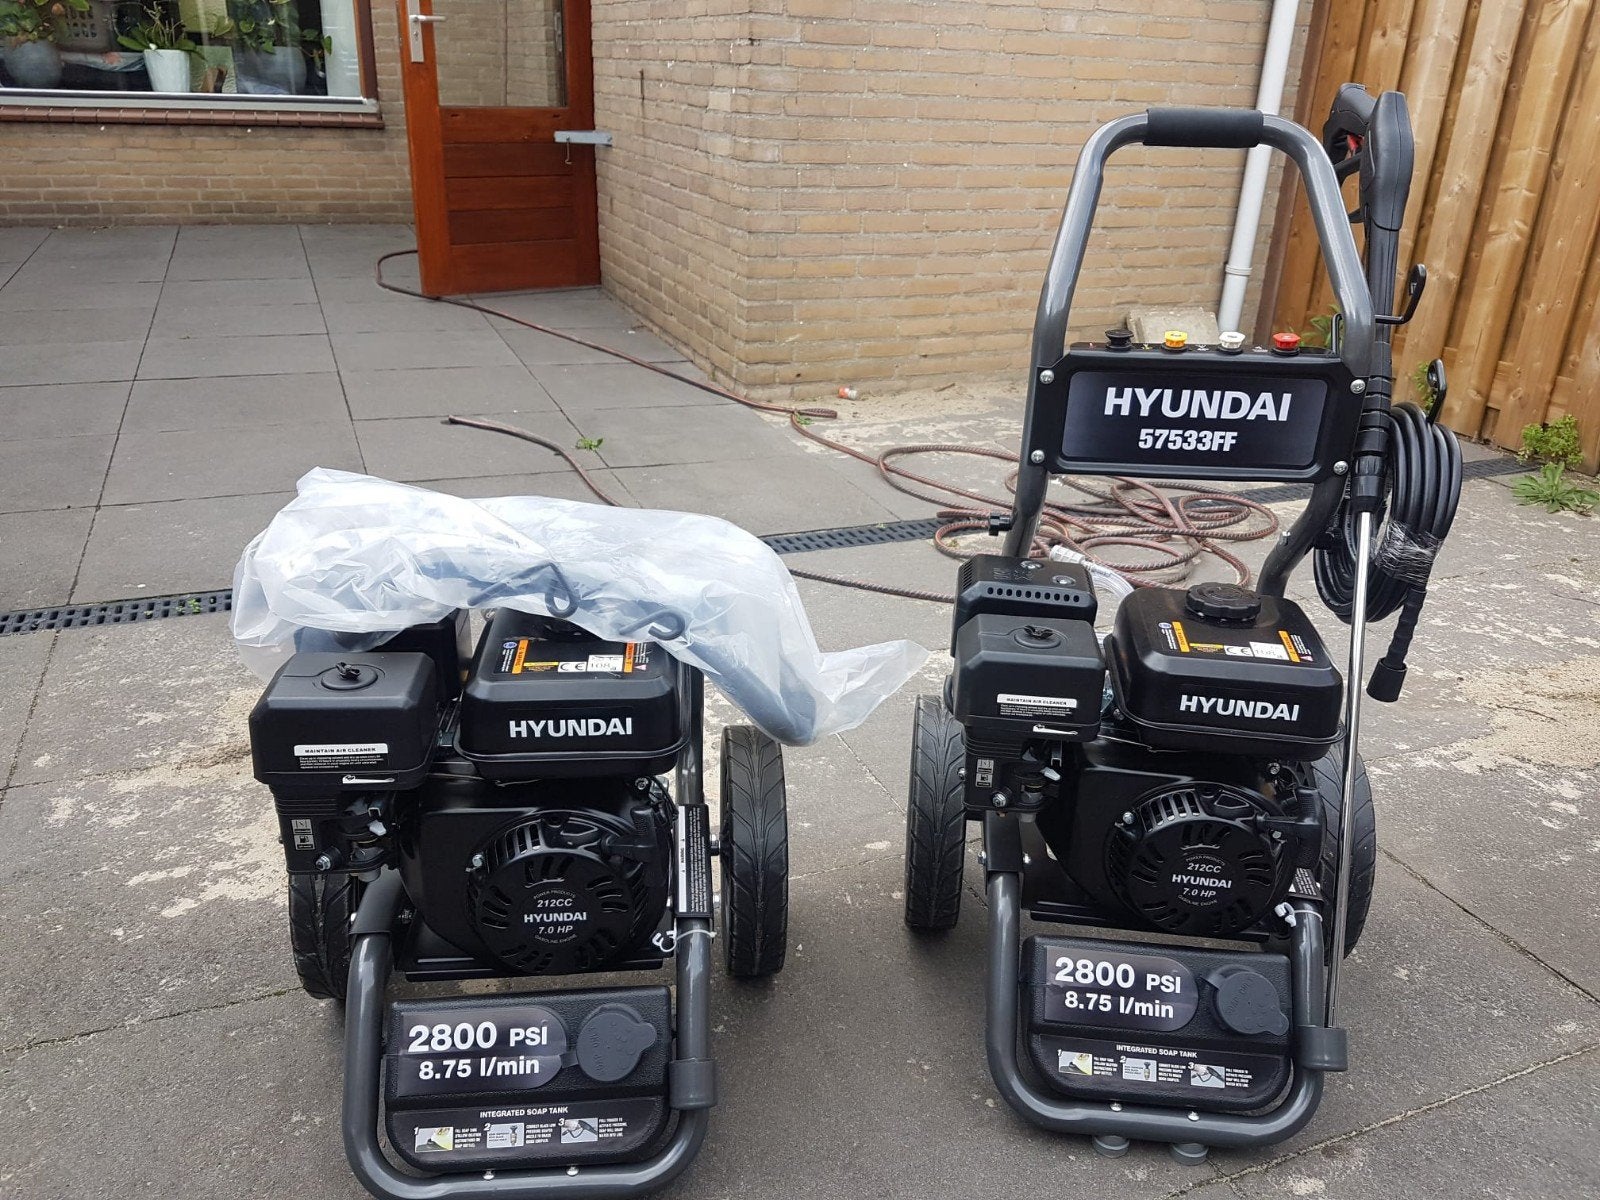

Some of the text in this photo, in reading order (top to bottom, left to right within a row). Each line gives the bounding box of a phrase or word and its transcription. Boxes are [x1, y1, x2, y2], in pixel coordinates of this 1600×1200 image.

[1104, 386, 1292, 422] HYUNDAI
[1138, 428, 1238, 452] 57533FF
[1179, 694, 1300, 722] HYUNDAI
[509, 717, 633, 738] HYUNDAI
[1187, 862, 1222, 873] 212CC
[1171, 874, 1232, 889] HYUNDAI
[1183, 887, 1217, 898] 7.0 HP
[537, 898, 573, 908] 212CC
[523, 912, 587, 923] HYUNDAI
[538, 925, 573, 934] 7.0 HP
[1054, 956, 1182, 994] 2800 PSI
[1064, 991, 1174, 1019] 8.75 l/min
[407, 1021, 548, 1053] 2800 PSI
[1116, 1044, 1198, 1059] INTEGRATED SOAP TANK
[1120, 1055, 1127, 1063] 2
[418, 1056, 540, 1080] 8.75 l/min
[1187, 1062, 1195, 1070] 3
[480, 1106, 569, 1118] INTEGRATED SOAP TANK
[484, 1123, 492, 1132] 2
[558, 1118, 565, 1126] 3
[413, 1126, 419, 1135] 1
